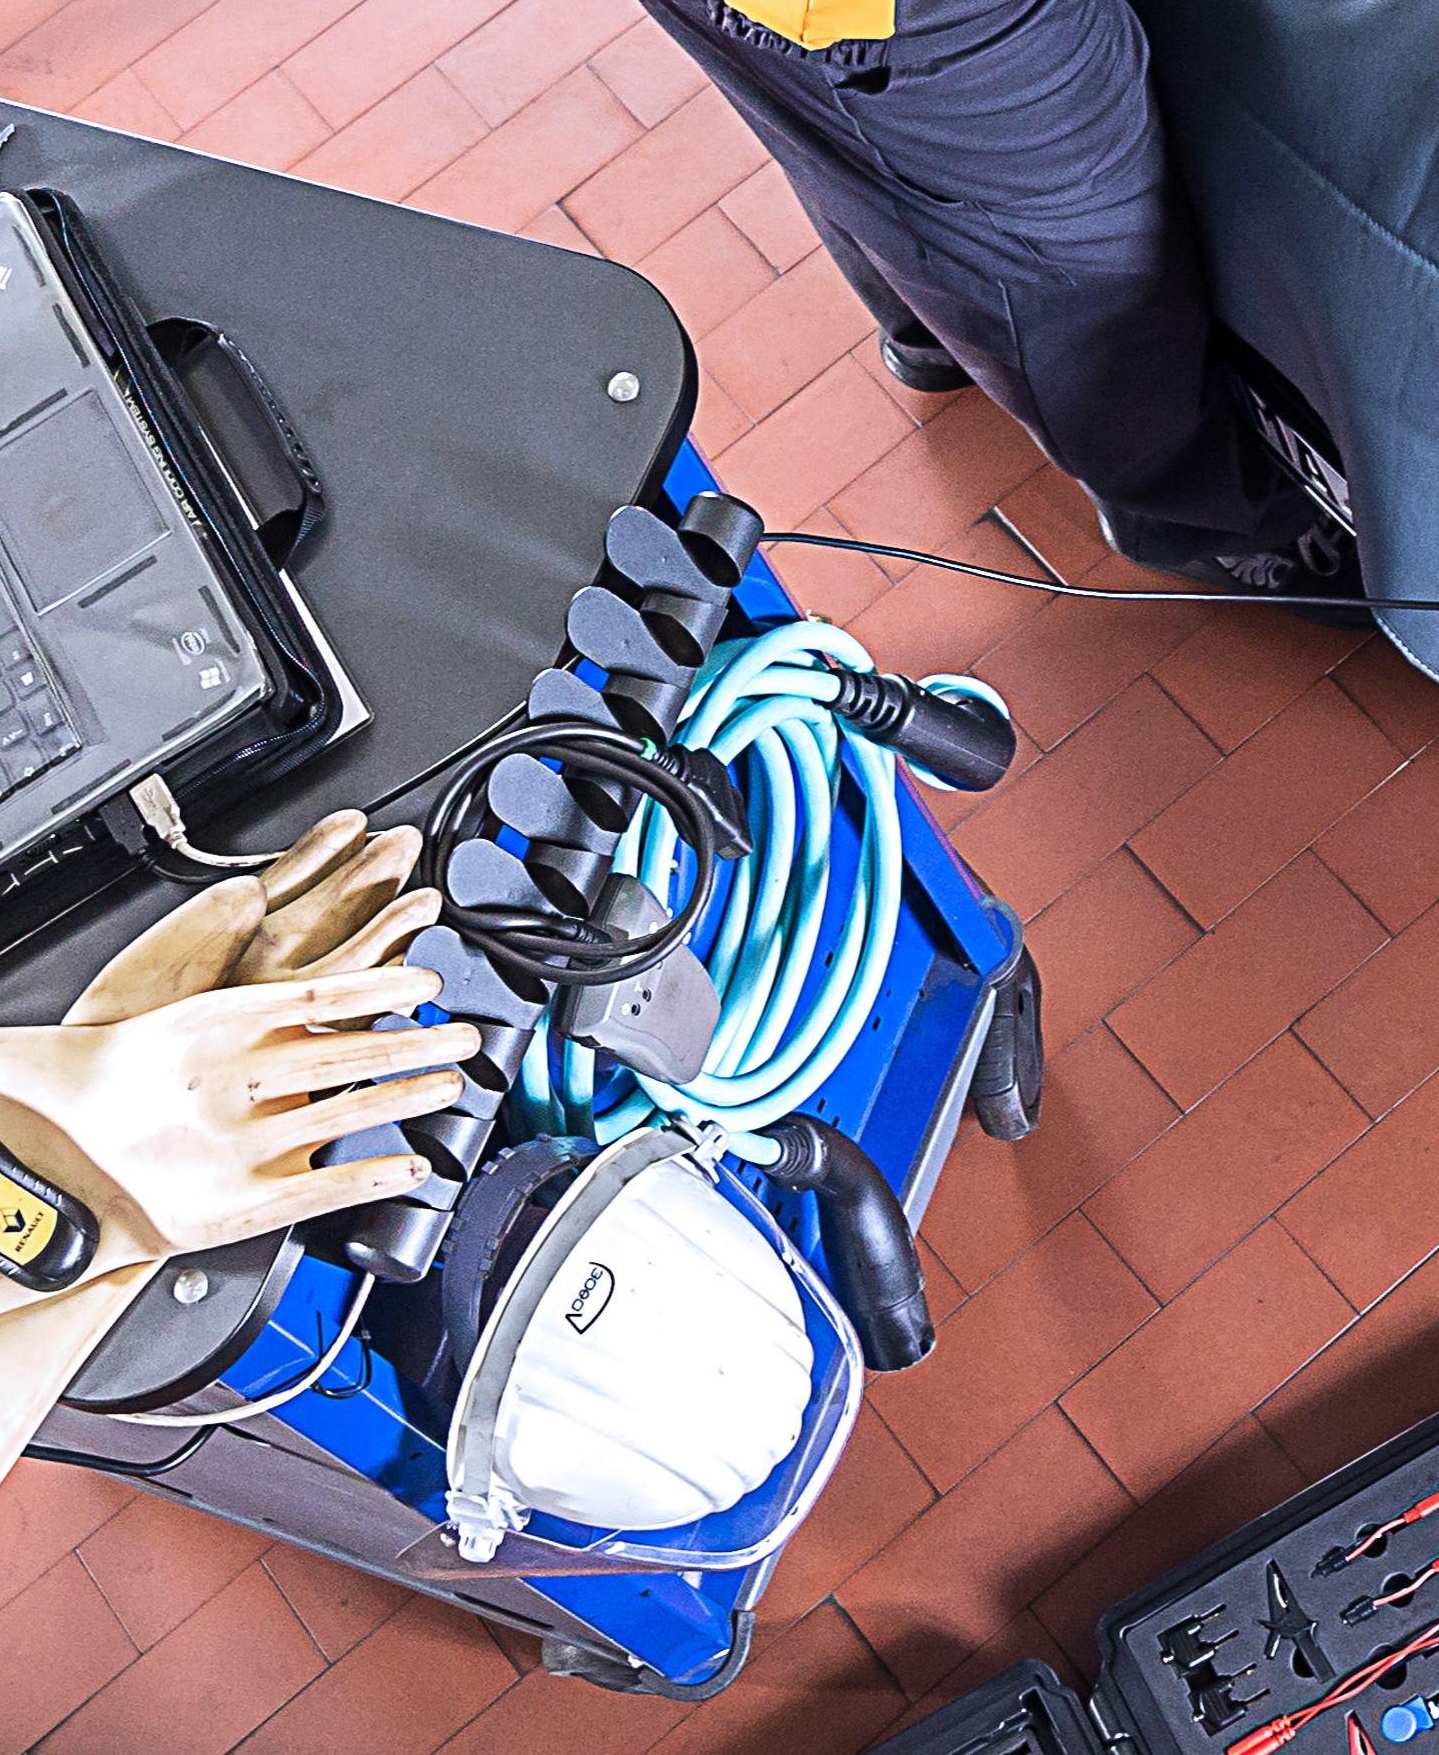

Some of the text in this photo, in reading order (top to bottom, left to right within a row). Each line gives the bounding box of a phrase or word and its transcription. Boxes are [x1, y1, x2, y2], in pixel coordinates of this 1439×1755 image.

[123, 394, 158, 446] SYSTEM
[179, 498, 198, 521] AIR
[14, 1211, 45, 1253] RENAULT
